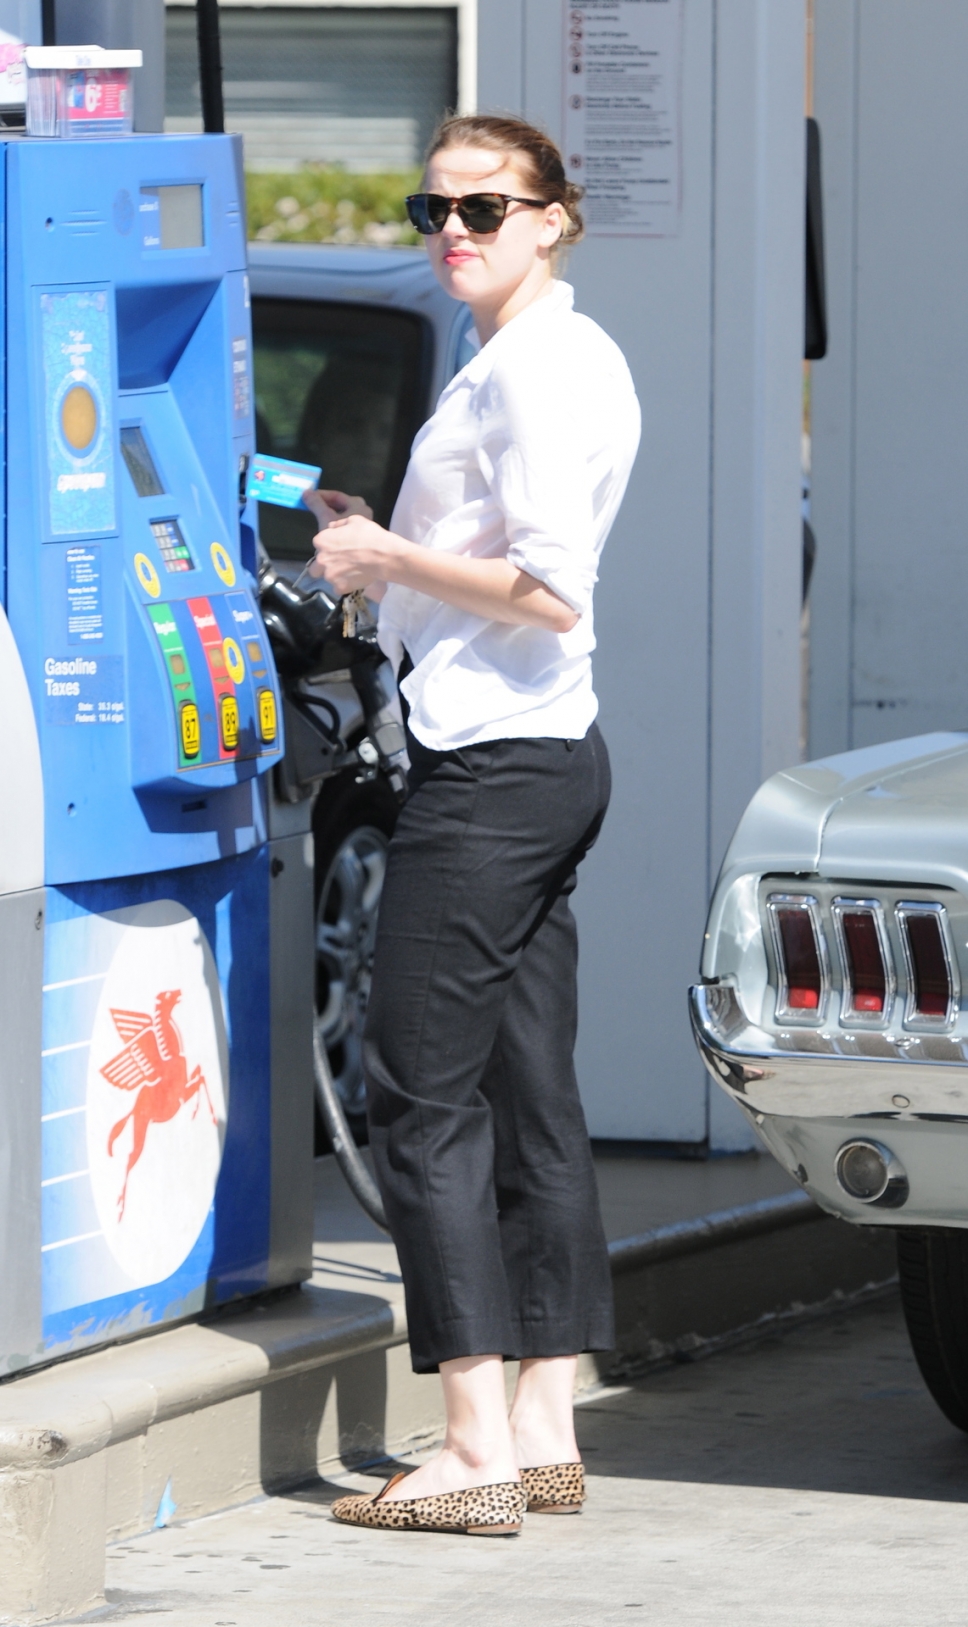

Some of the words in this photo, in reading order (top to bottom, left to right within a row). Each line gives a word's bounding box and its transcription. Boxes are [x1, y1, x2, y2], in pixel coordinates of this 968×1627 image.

[44, 657, 98, 676] Gasoline
[44, 678, 81, 697] Taxes
[224, 711, 237, 733] 89
[262, 705, 273, 726] 91
[185, 718, 197, 740] 87
